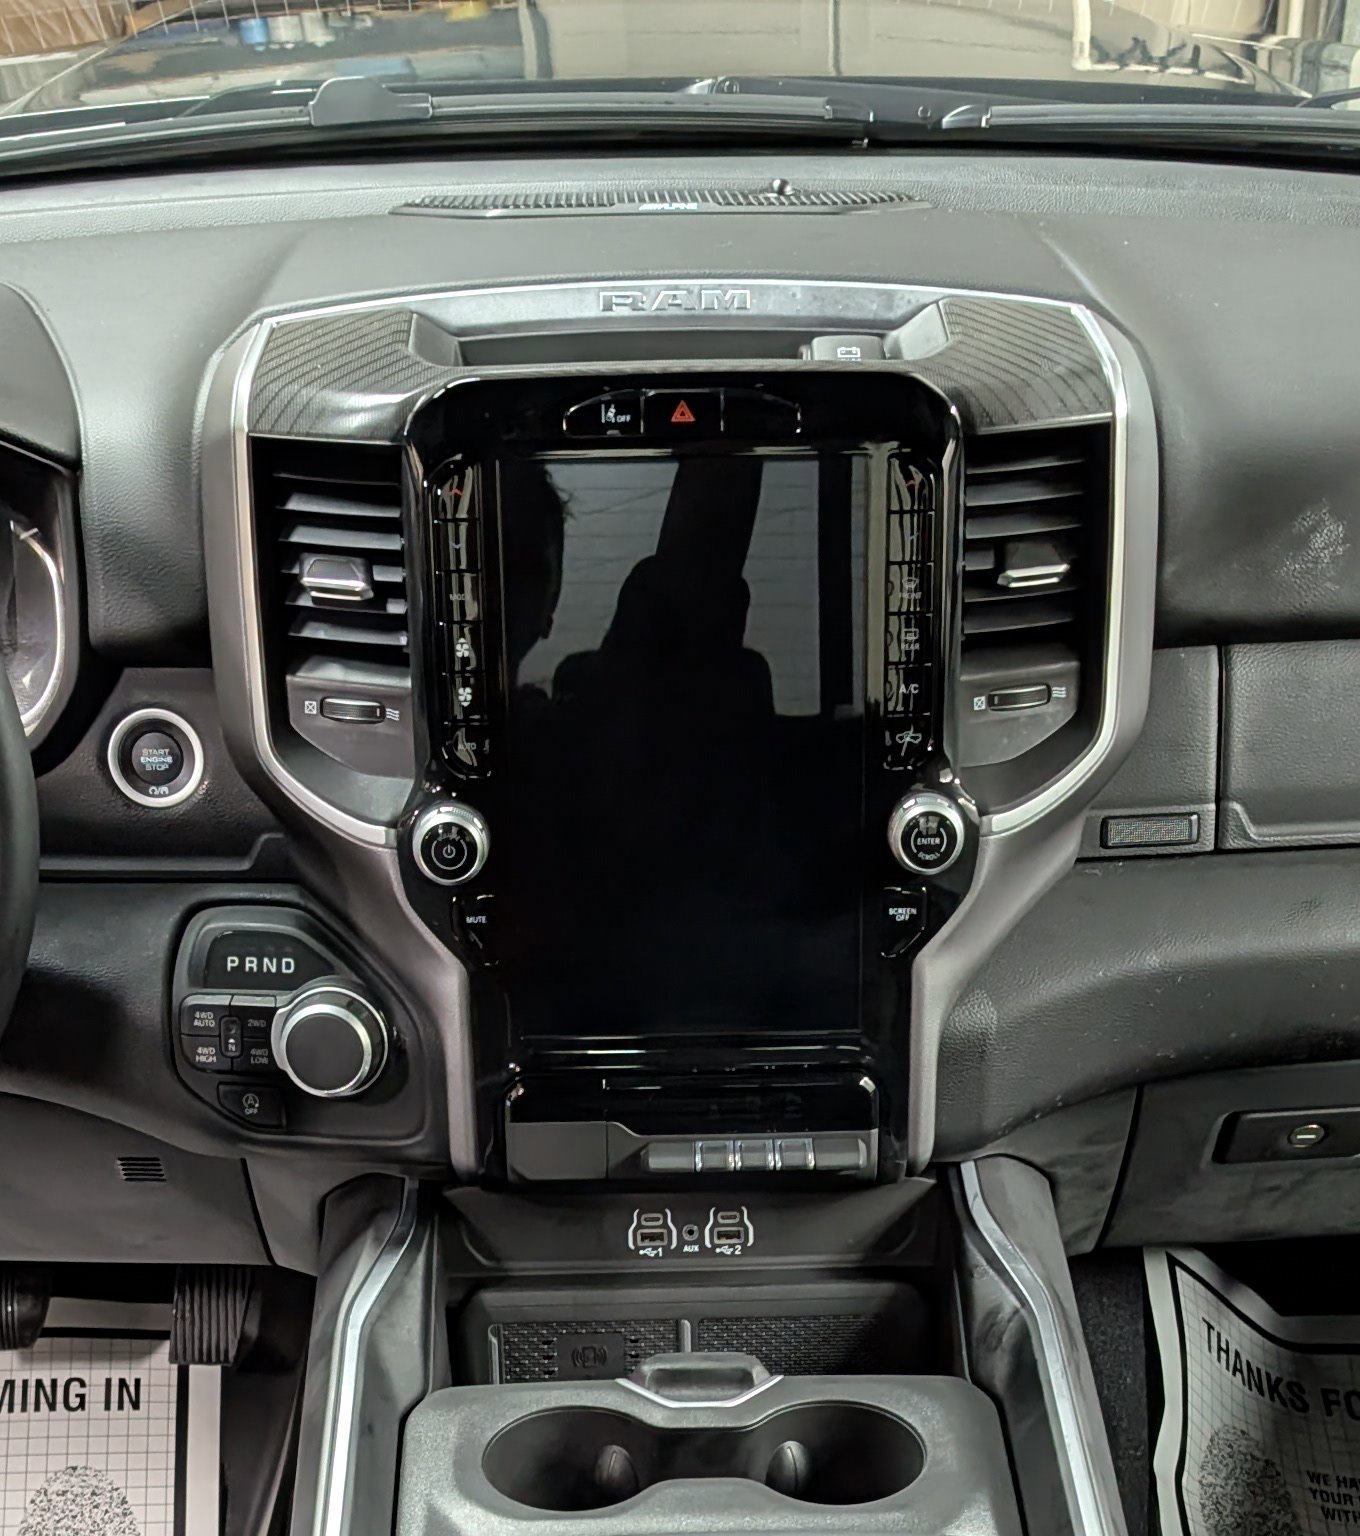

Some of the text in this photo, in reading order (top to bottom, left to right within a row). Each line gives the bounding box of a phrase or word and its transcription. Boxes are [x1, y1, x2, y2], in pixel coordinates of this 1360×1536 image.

[599, 290, 750, 311] RAM
[617, 414, 631, 423] OFF
[899, 684, 919, 694] A/C
[142, 748, 170, 756] START
[145, 763, 169, 771] STOP
[917, 837, 940, 845] ENTER
[466, 916, 487, 924] MUTE
[194, 1011, 214, 1020] 4WD
[193, 1019, 216, 1028] AUTO
[247, 1019, 266, 1028] 2WD
[196, 1046, 216, 1055] 4WD
[195, 1055, 217, 1063] HIGH
[682, 1245, 700, 1253] AUX
[1202, 1317, 1310, 1414] THANKS
[104, 1377, 141, 1412] IN
[1307, 1471, 1332, 1487] WE
[1309, 1487, 1353, 1507] YOUR
